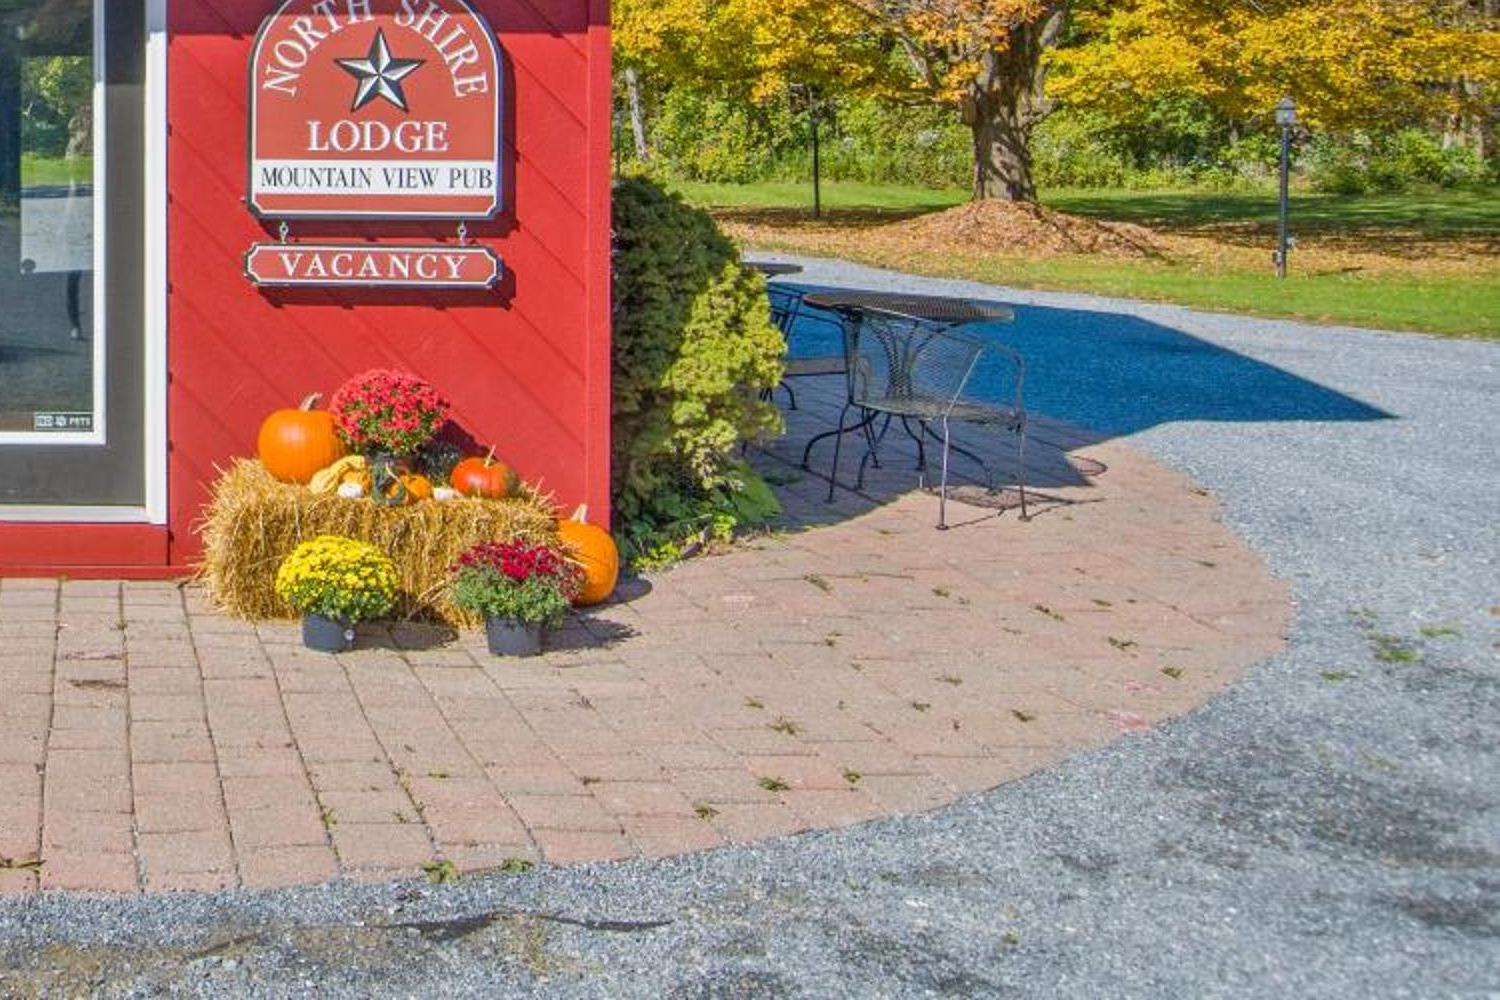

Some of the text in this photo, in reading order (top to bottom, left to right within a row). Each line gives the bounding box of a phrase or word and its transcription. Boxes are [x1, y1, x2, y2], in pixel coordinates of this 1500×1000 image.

[307, 120, 449, 153] LODGE
[261, 166, 494, 190] MOUNTAIN VIEW PUB
[278, 253, 468, 280] VACANCY
